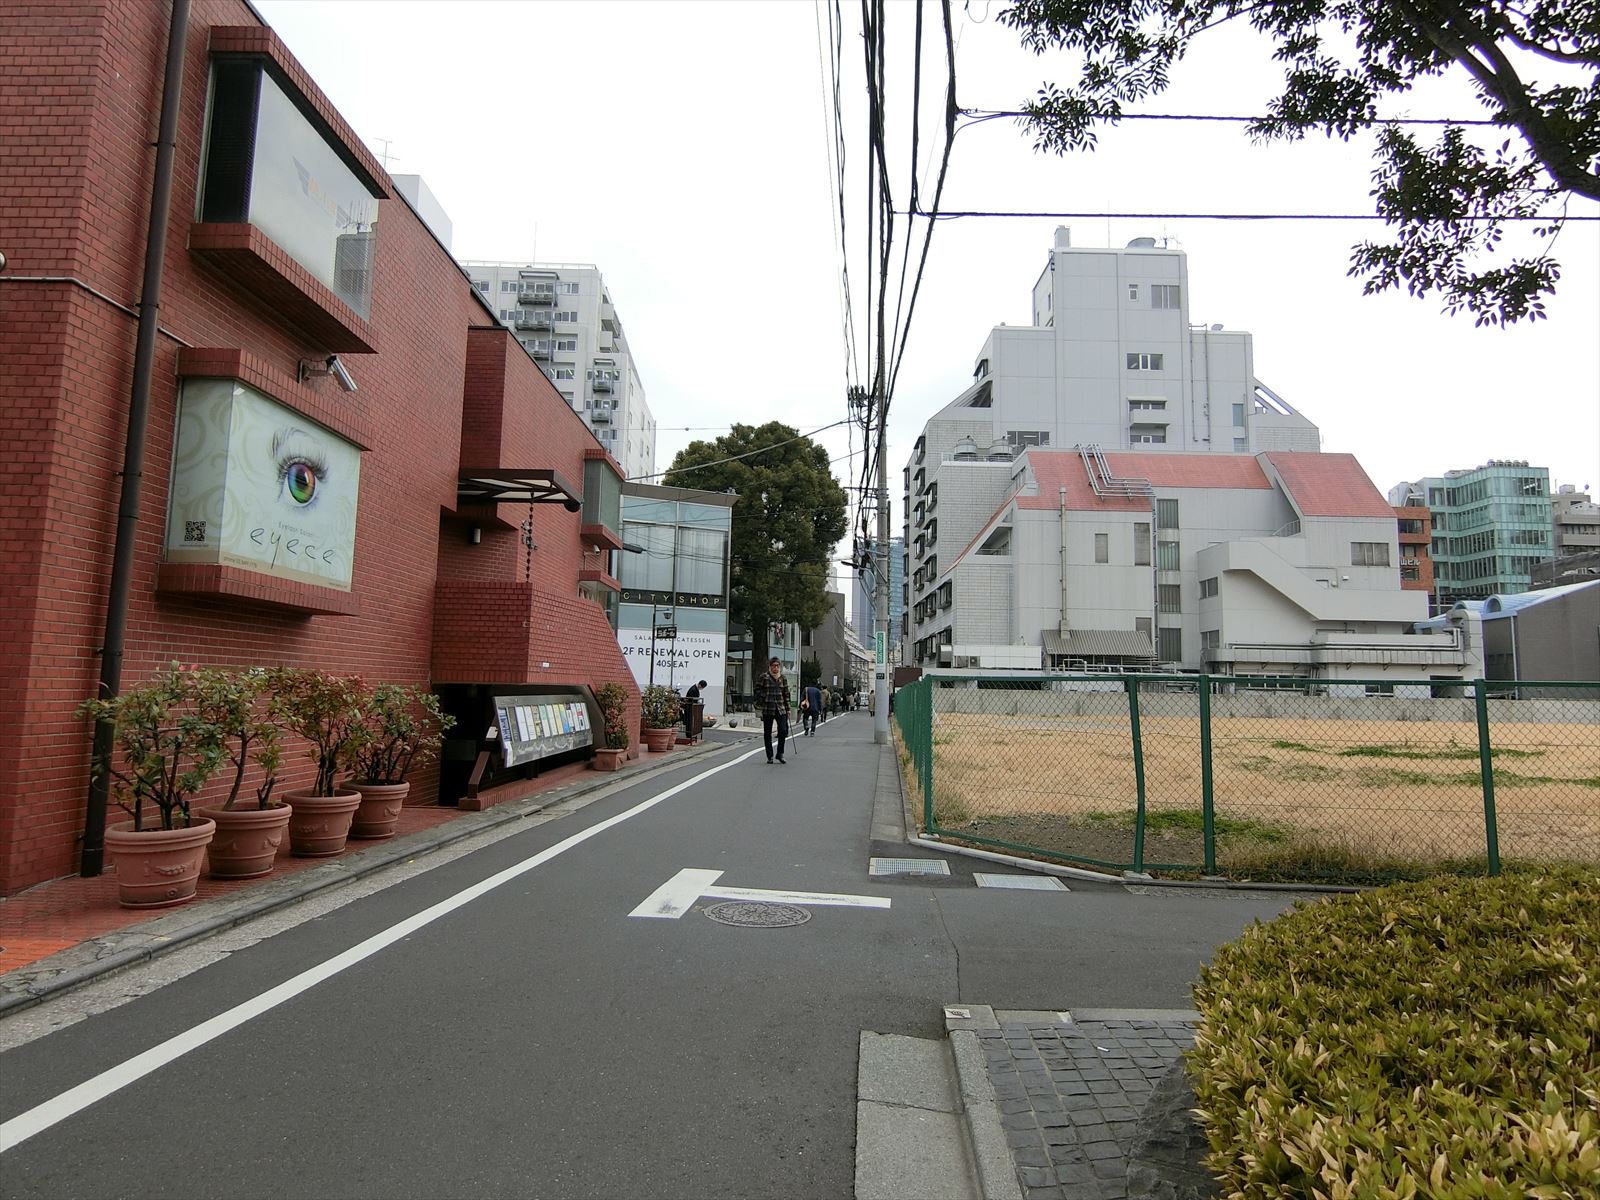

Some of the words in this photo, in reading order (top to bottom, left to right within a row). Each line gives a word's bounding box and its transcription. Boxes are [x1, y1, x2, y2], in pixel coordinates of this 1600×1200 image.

[623, 592, 669, 602] CITY
[679, 595, 720, 605] SHOP
[623, 646, 635, 656] 2F
[638, 647, 690, 657] RENEWAL
[692, 649, 720, 658] OPEN
